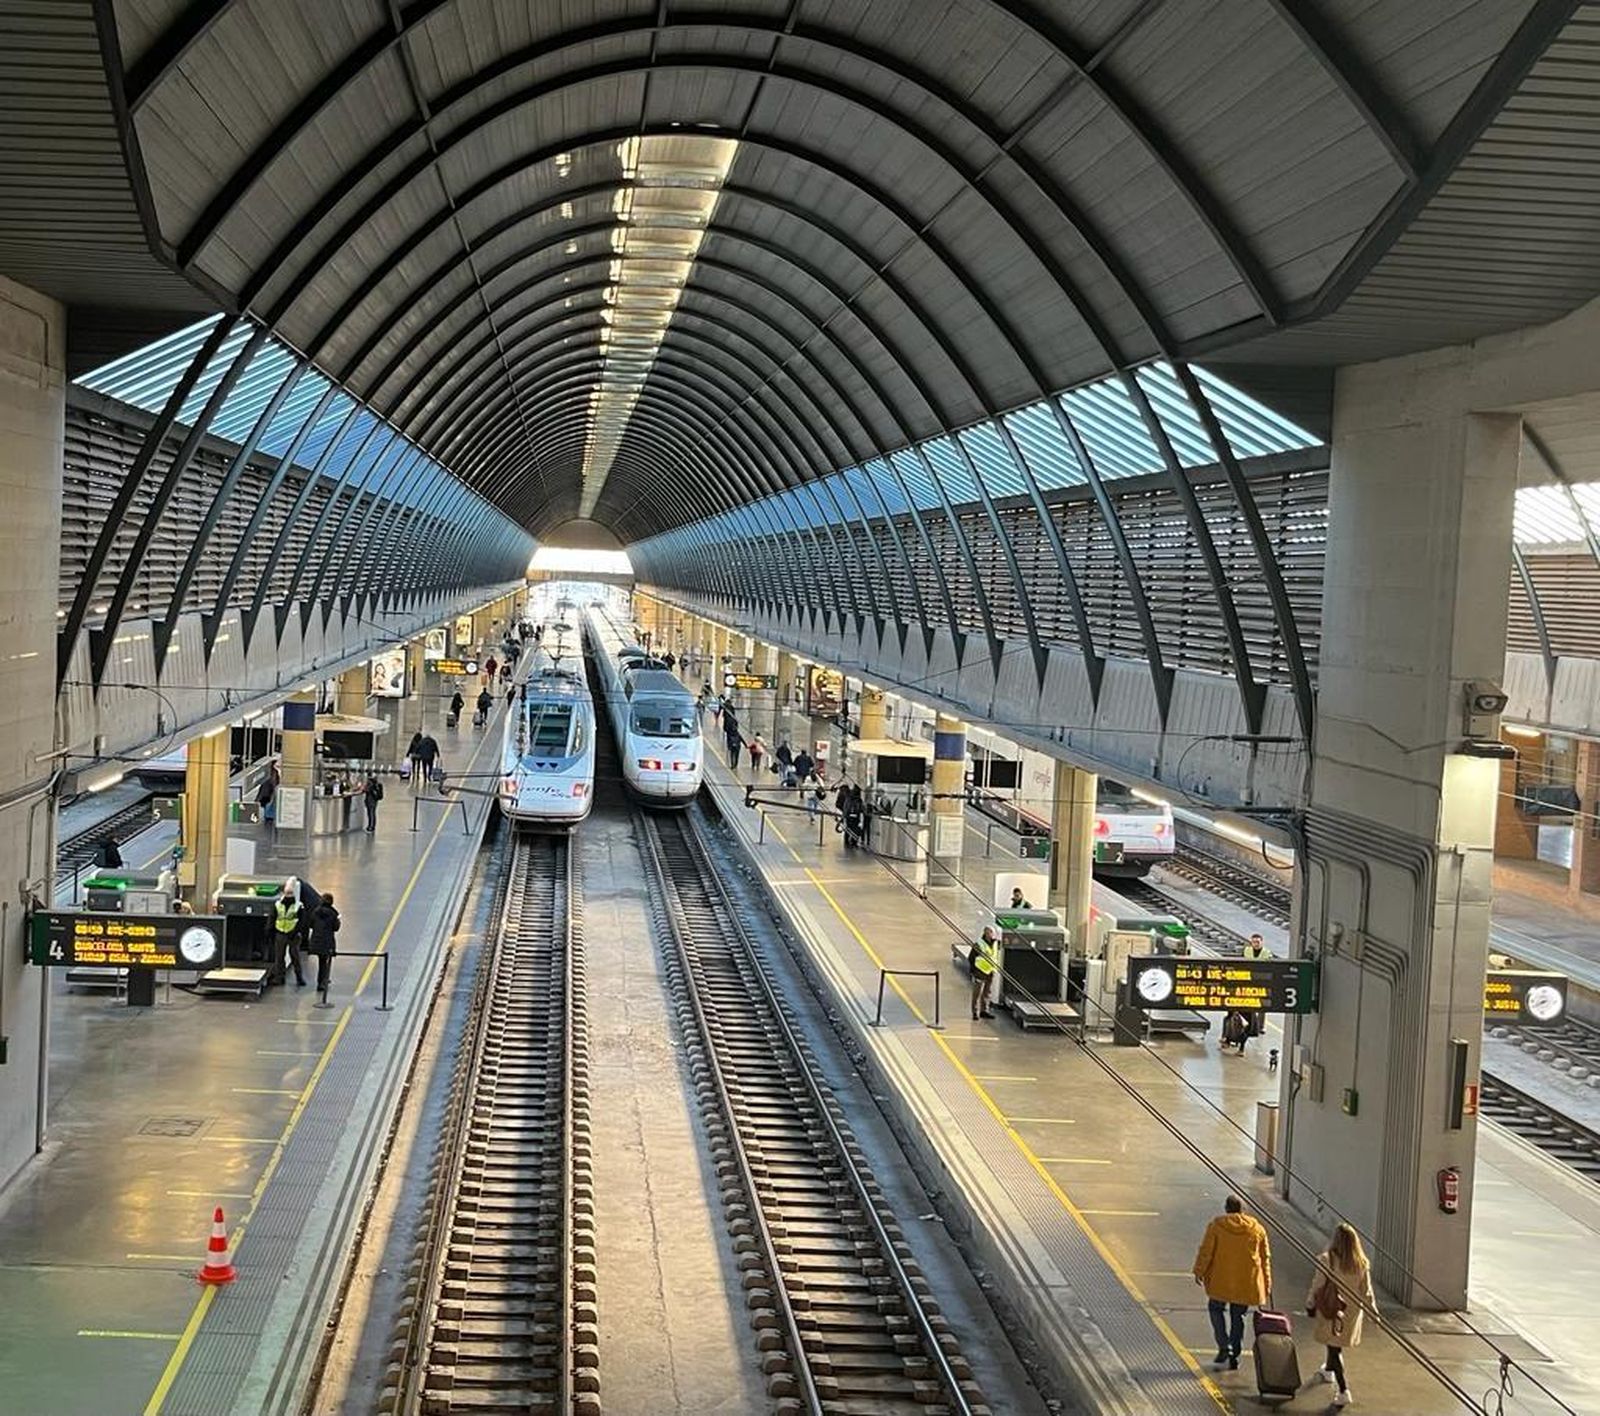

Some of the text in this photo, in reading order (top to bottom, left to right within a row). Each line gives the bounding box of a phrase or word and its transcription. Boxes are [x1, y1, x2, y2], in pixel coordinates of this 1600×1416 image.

[250, 813, 259, 824] 4
[1020, 846, 1027, 857] 3
[1115, 852, 1124, 862] 2
[49, 940, 65, 960] 4
[74, 941, 124, 951] BARCELONA
[1175, 985, 1206, 995] MADRID
[1235, 987, 1267, 997] ATOCHA
[1184, 996, 1206, 1006] PARA
[1284, 987, 1297, 1007] 3
[1493, 999, 1520, 1010] JUSTA
